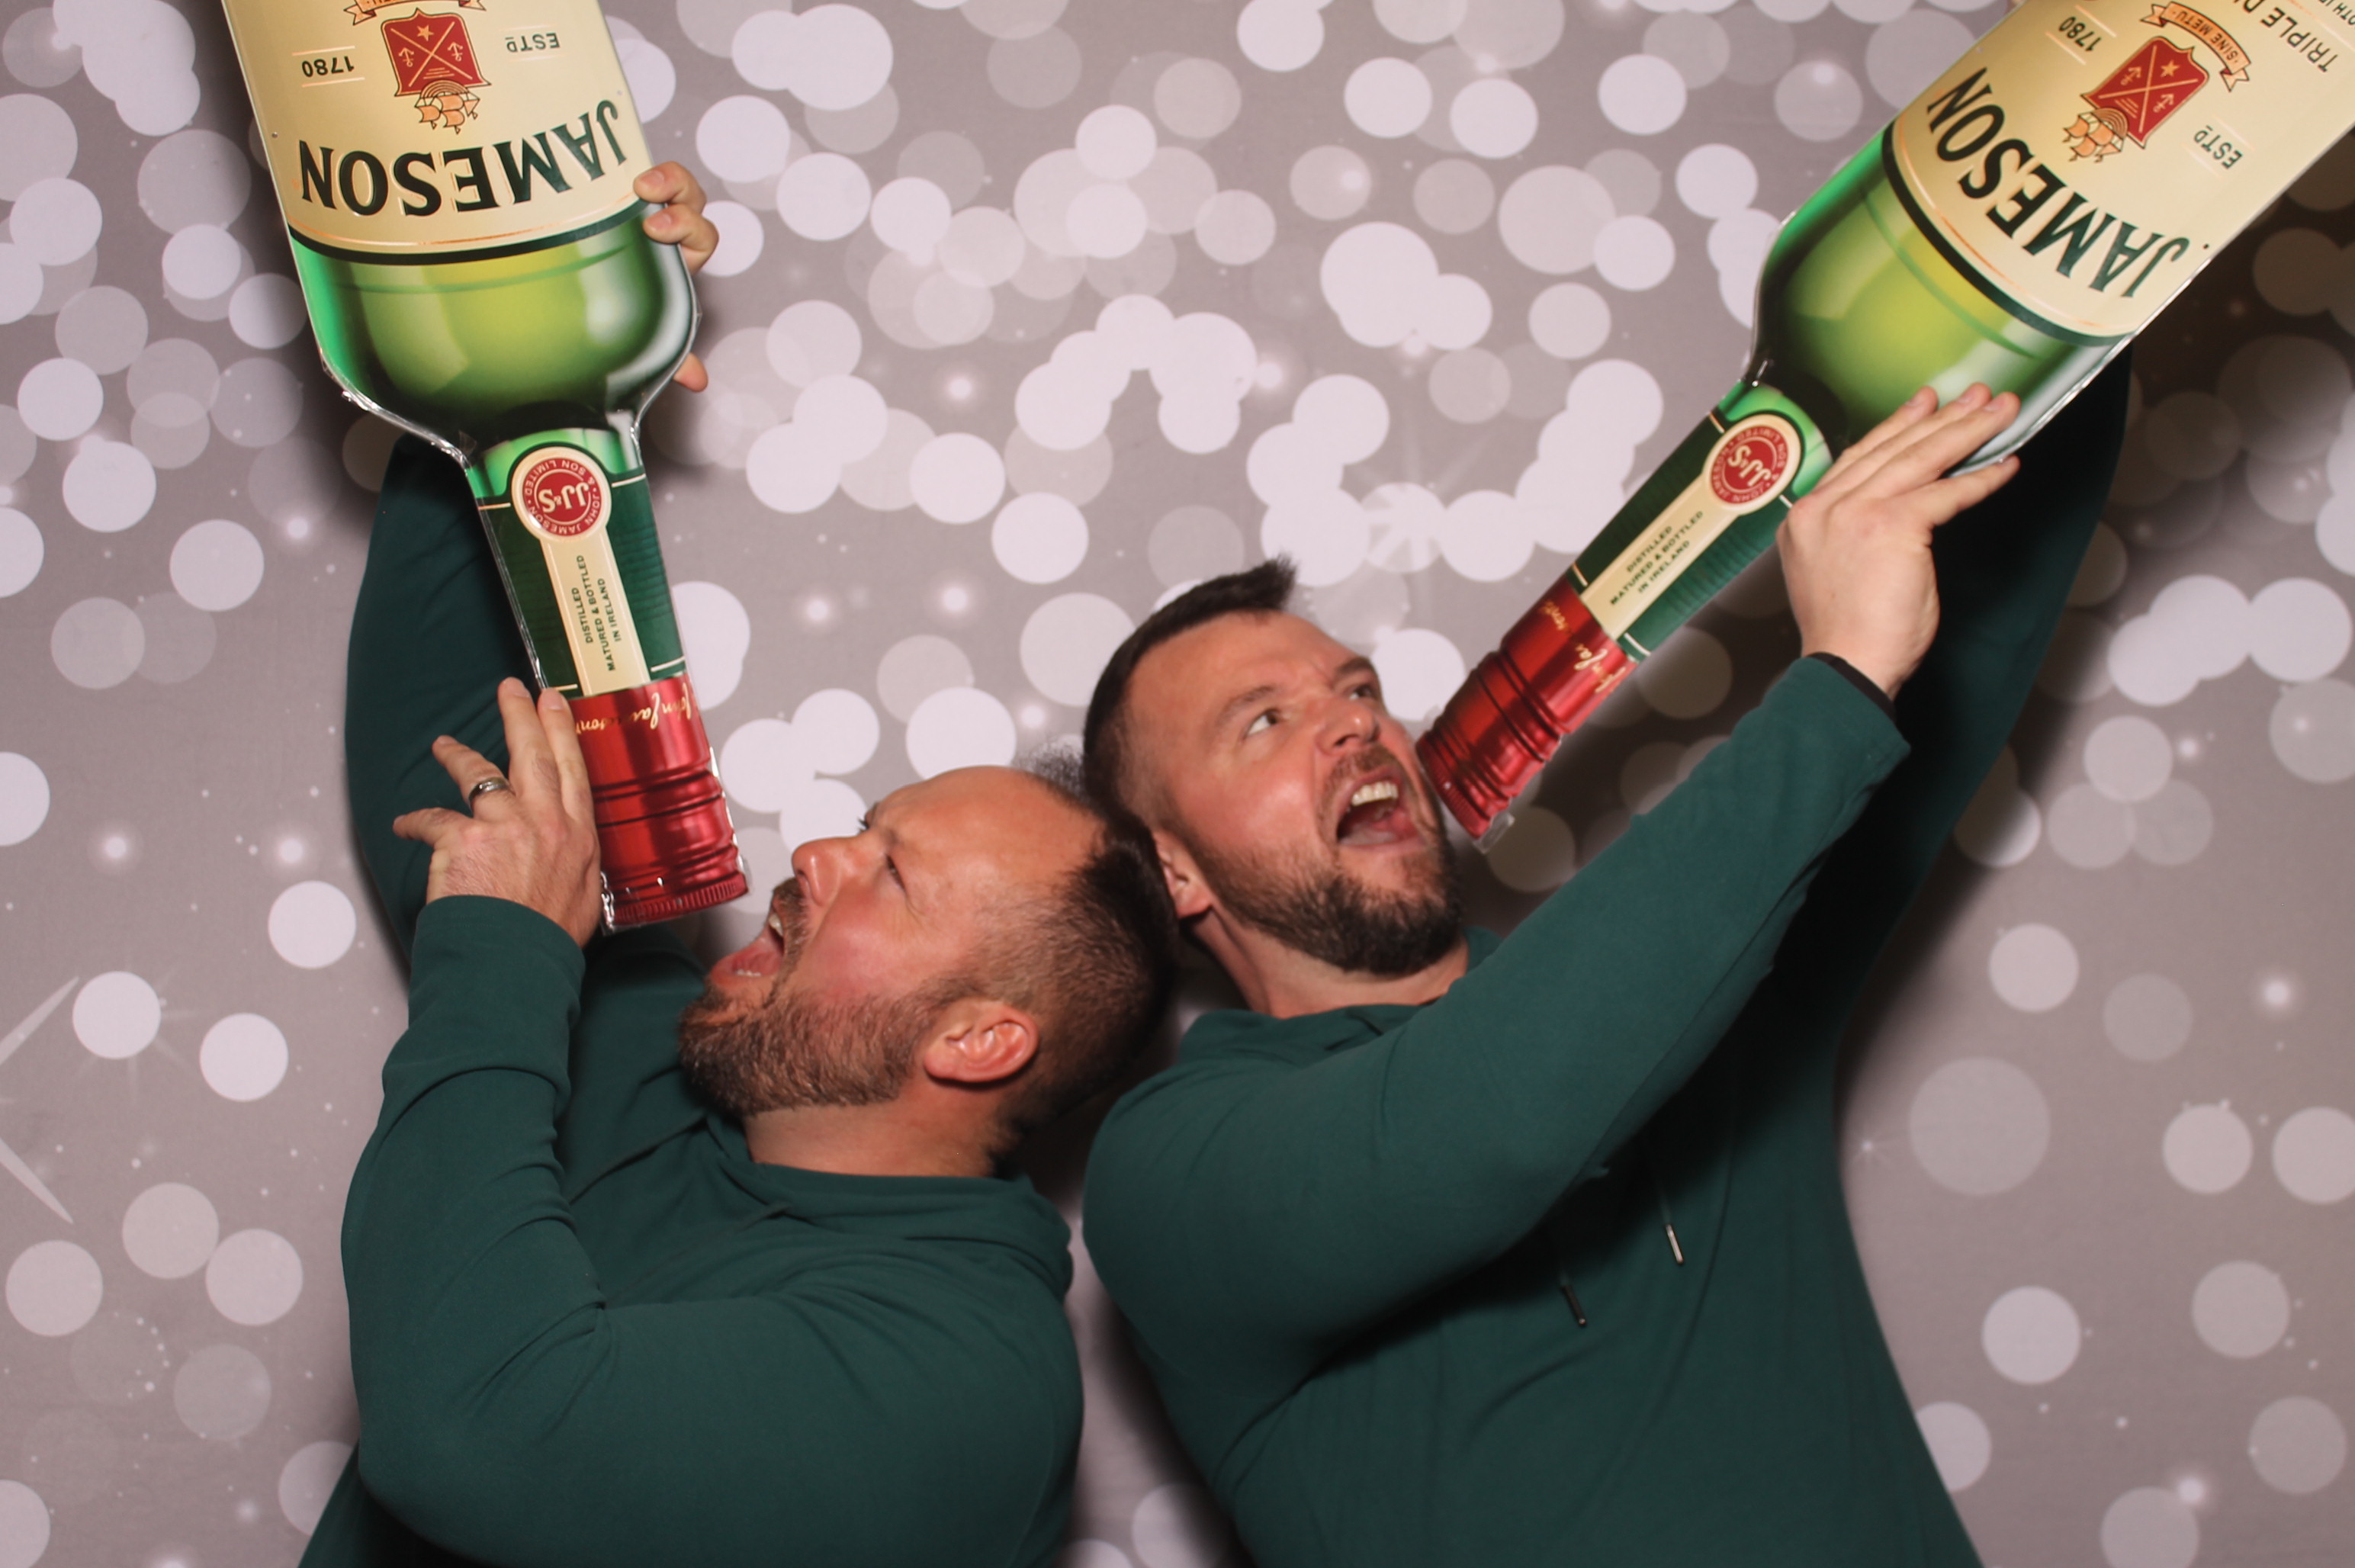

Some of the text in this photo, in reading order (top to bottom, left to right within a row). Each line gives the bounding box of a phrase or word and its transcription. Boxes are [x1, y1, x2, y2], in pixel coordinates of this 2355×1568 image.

[2058, 16, 2102, 52] 1780
[2174, 10, 2238, 60] SINE METU
[2260, 7, 2337, 72] TRIPLE
[300, 56, 355, 77] 1780
[298, 99, 627, 217] JAMESON
[1926, 67, 2190, 298] JAMESON
[525, 459, 557, 496] LIMITED
[561, 459, 586, 476] SON
[529, 493, 600, 535] JOHN JAMESON
[538, 482, 590, 513] JJ&S
[571, 587, 593, 644] DISTILLED
[577, 555, 615, 671] MATURED & BOTTLED
[597, 578, 622, 641] IN IRELAND
